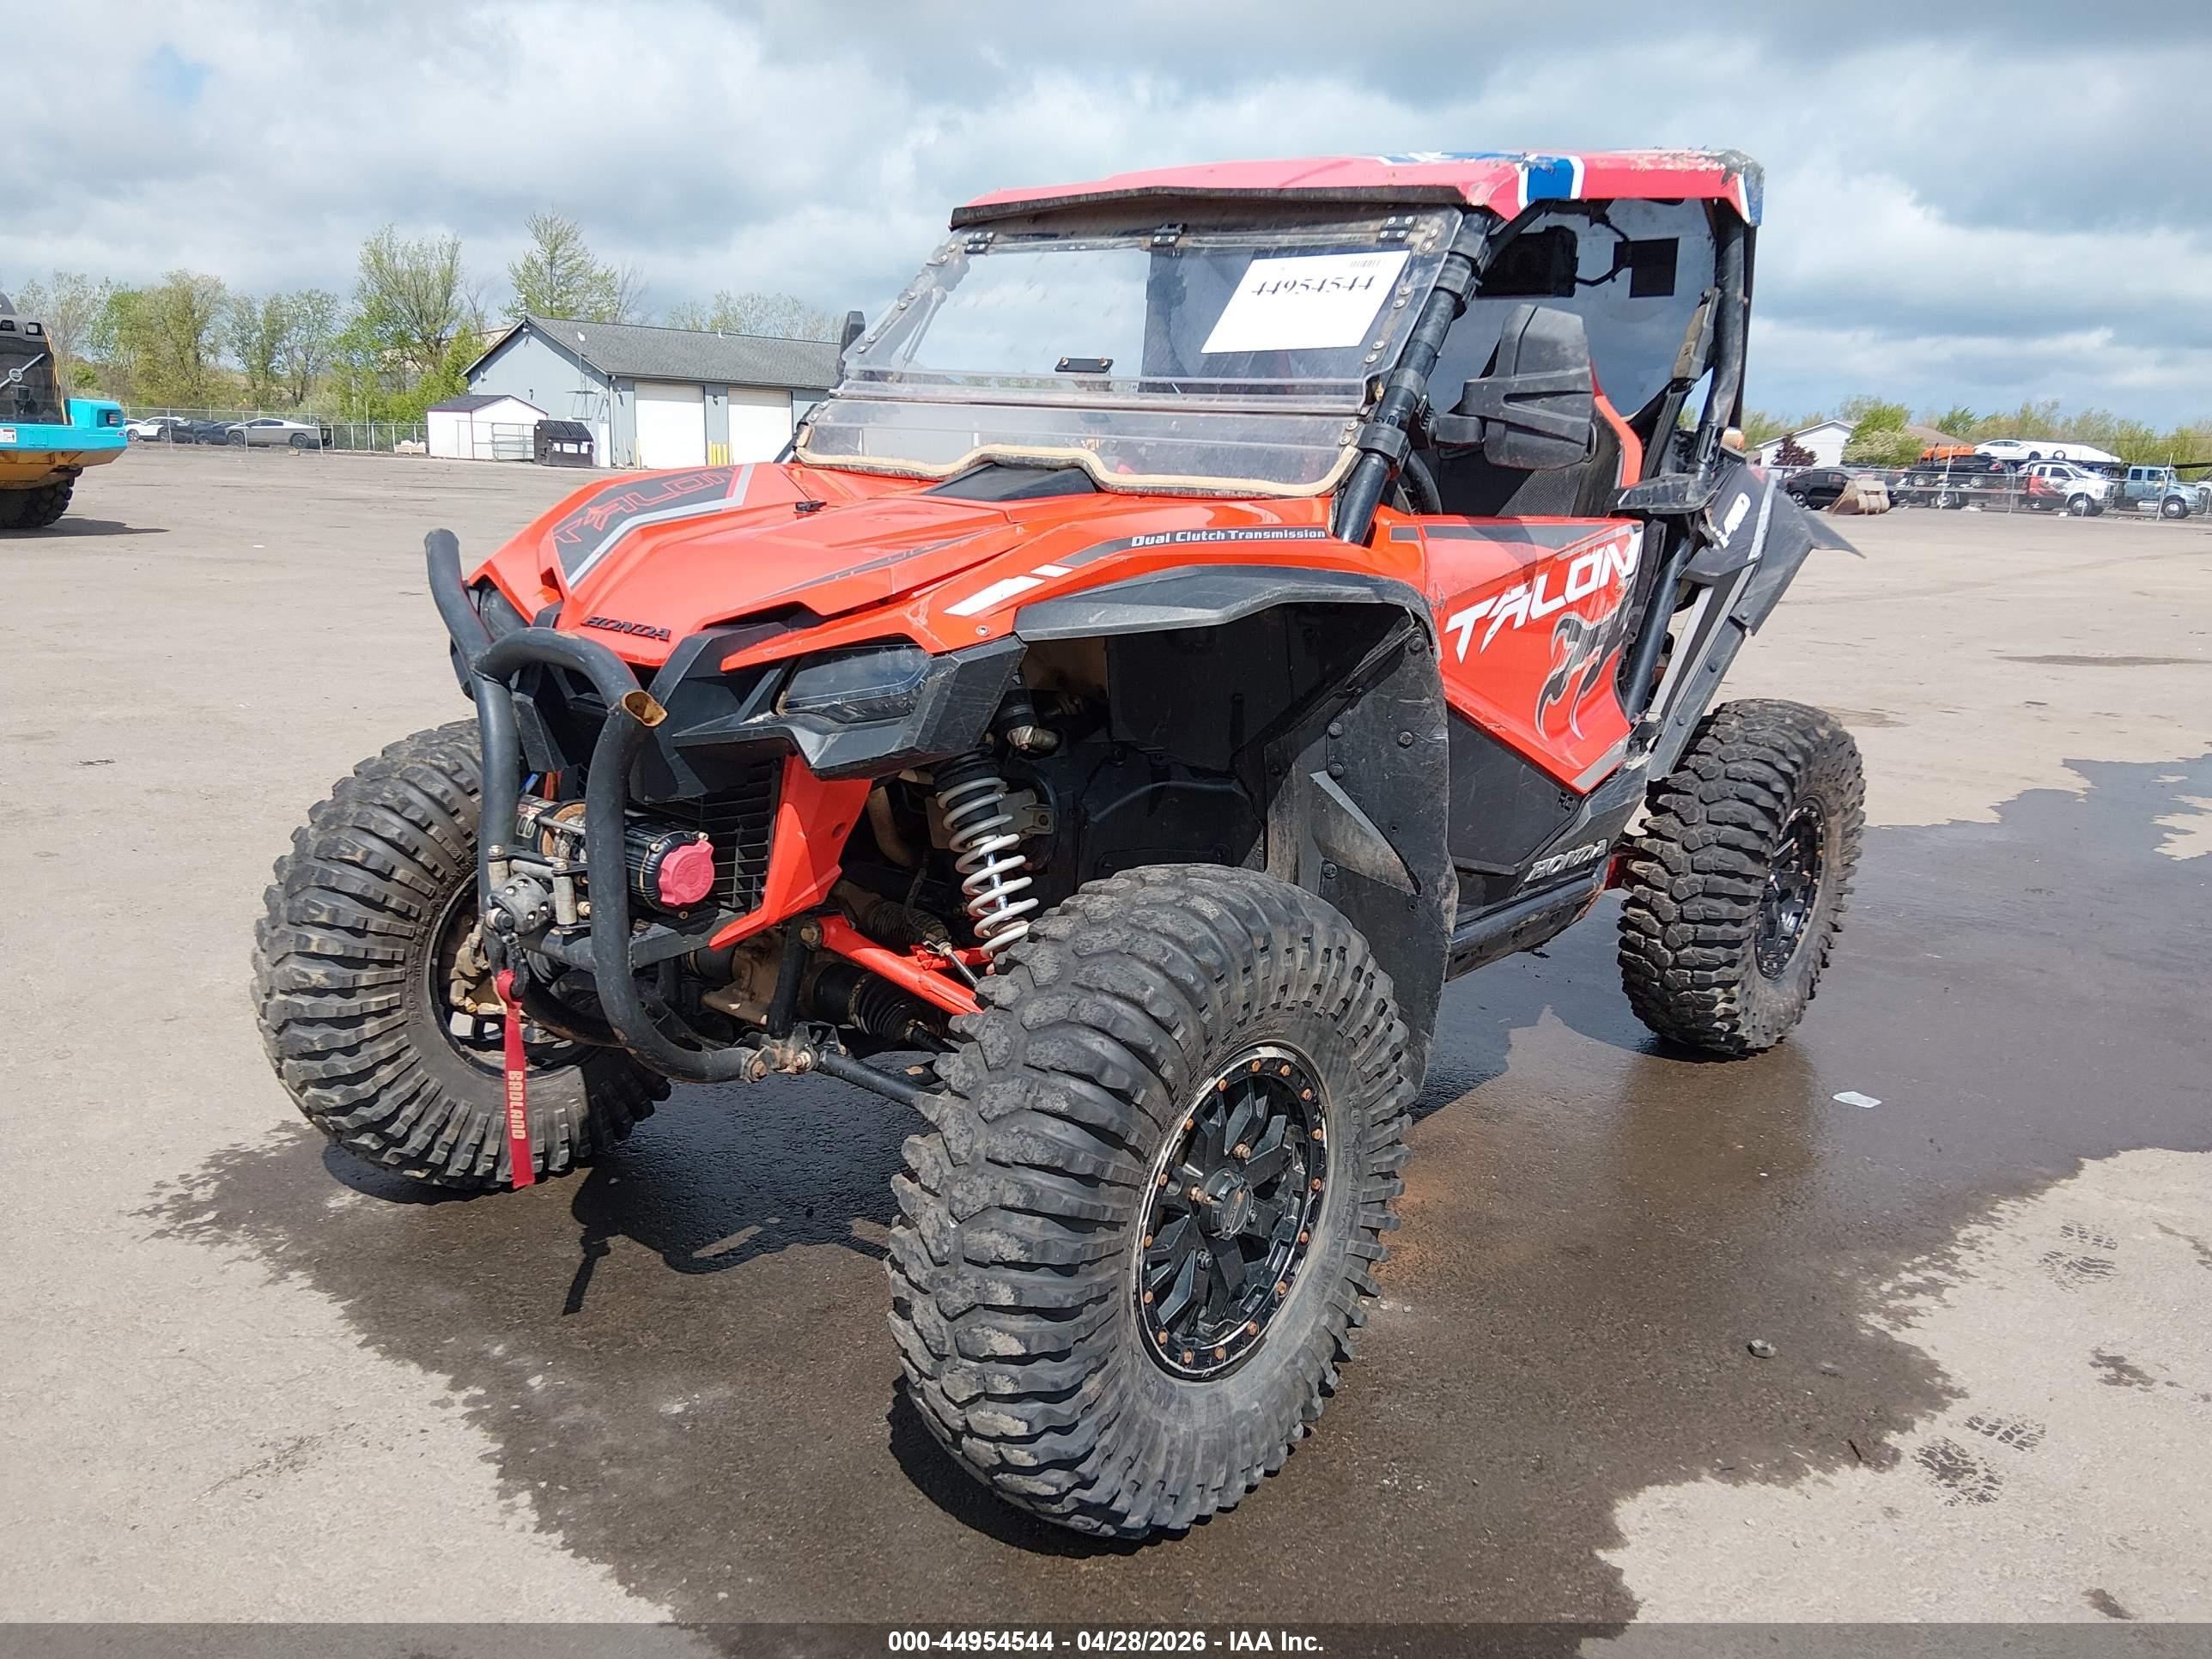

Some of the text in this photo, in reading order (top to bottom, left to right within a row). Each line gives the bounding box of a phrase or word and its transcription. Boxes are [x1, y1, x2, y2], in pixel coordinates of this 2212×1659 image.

[1130, 529, 1326, 548] Dual Clutch Transmission
[1444, 531, 1644, 665] TALON
[582, 616, 672, 641] HONDA
[1523, 839, 1607, 884] HONDA
[507, 1070, 526, 1140] BADLAND
